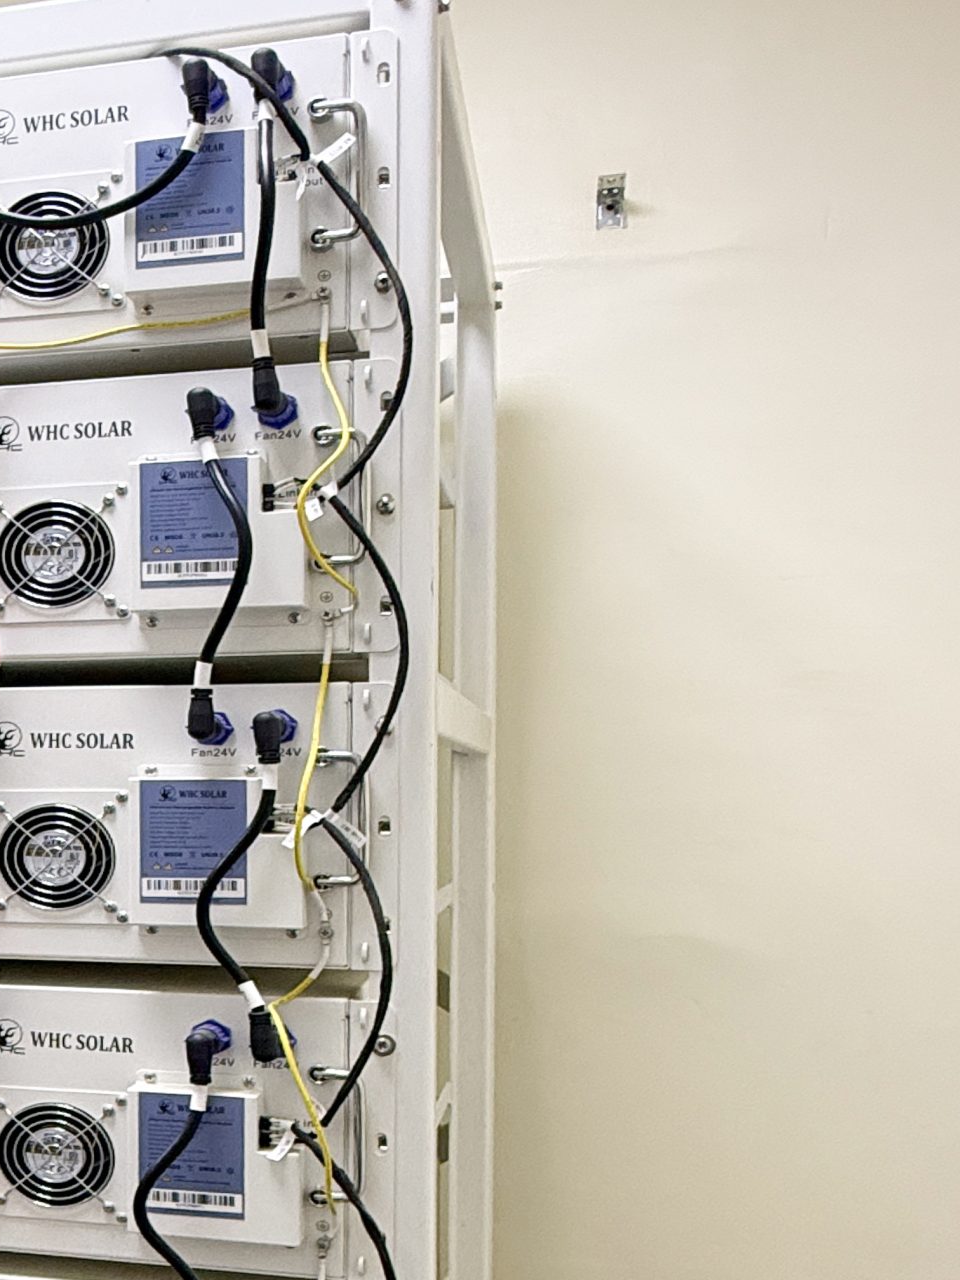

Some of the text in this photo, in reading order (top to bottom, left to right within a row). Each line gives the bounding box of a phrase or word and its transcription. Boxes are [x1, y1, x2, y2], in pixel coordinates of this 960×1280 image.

[24, 105, 129, 134] WHC SOLAR
[28, 421, 132, 441] WHC SOLAR
[254, 429, 302, 441] Fan24V
[30, 733, 134, 749] WHC SOLAR
[191, 747, 237, 758] Fan24V
[31, 1031, 133, 1053] WHC SOLAR
[253, 1057, 294, 1070] Fan24
